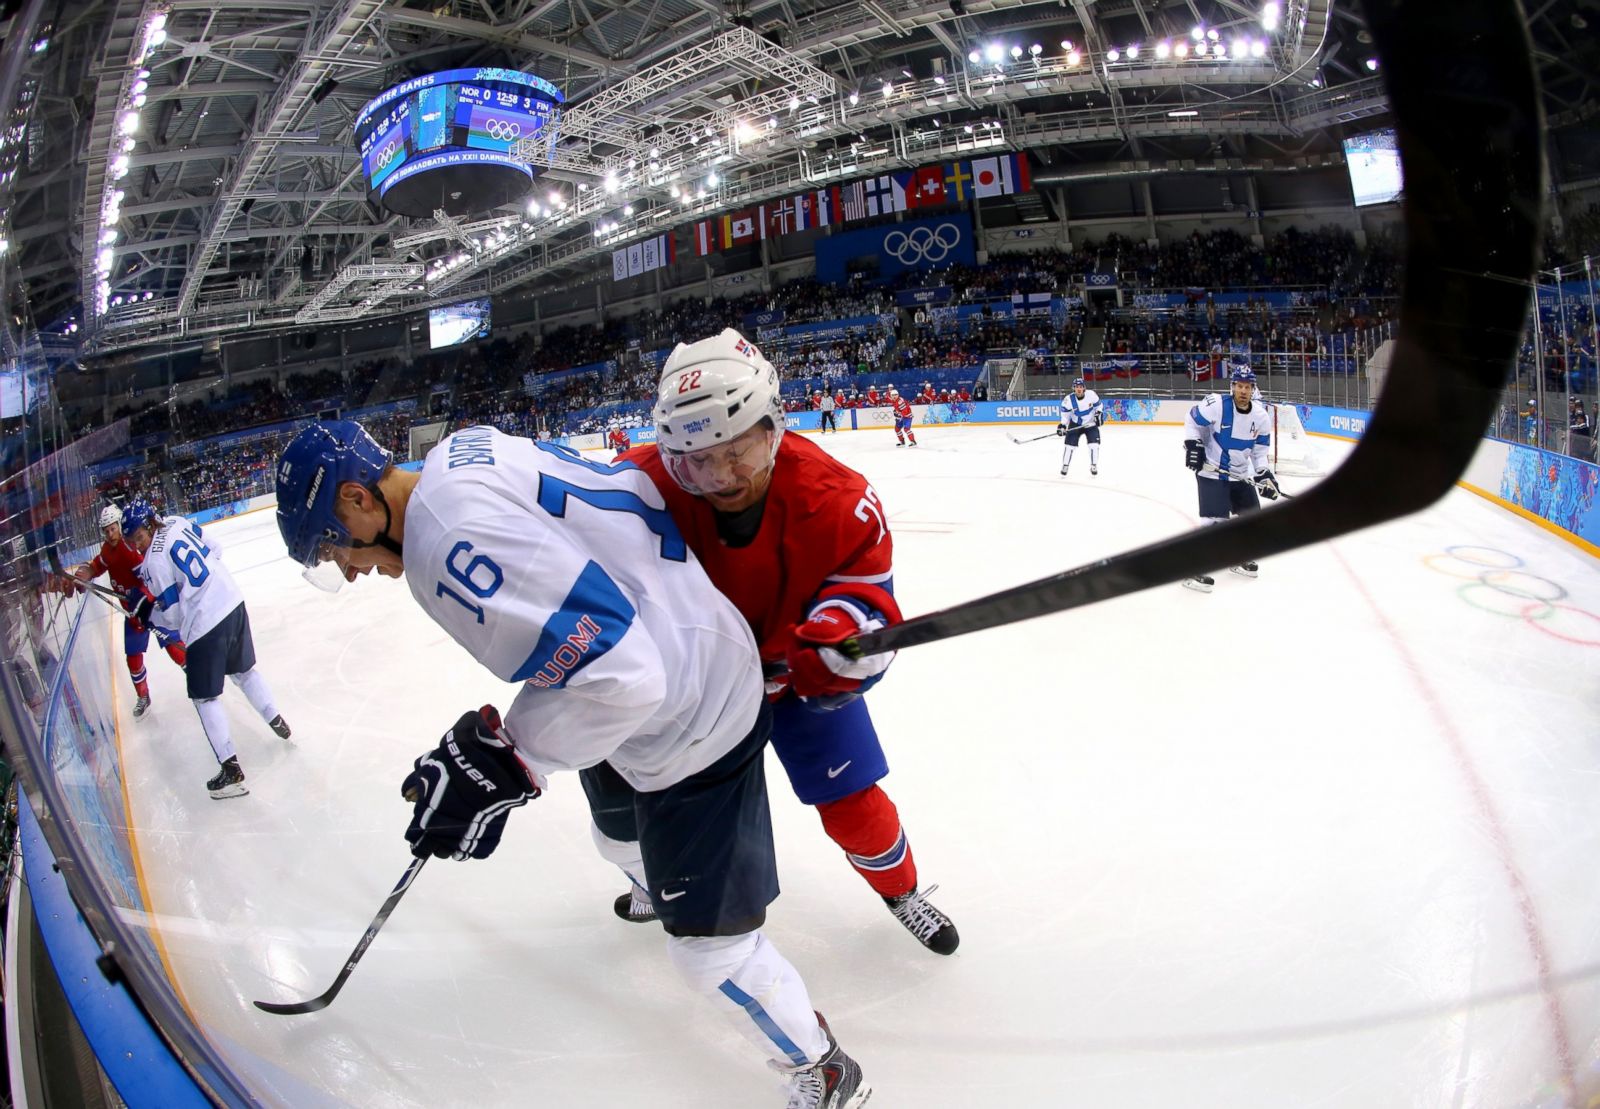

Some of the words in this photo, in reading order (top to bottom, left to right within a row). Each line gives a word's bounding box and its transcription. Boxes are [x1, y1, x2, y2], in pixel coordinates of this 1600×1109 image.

[400, 75, 434, 93] GAMES
[461, 87, 479, 97] NOR
[484, 90, 491, 100] 0
[497, 92, 518, 104] 12:58
[524, 98, 531, 108] 3
[537, 102, 549, 111] FIN
[462, 153, 478, 161] XXII
[678, 370, 702, 394] 22
[683, 417, 711, 430] sochi.ru
[997, 406, 1030, 418] SOCHI
[1033, 405, 1060, 417] 2014
[1249, 421, 1256, 433] A
[306, 466, 325, 510] BAUER
[169, 524, 211, 588] 64
[435, 540, 504, 625] 16
[446, 729, 497, 793] BAUER
